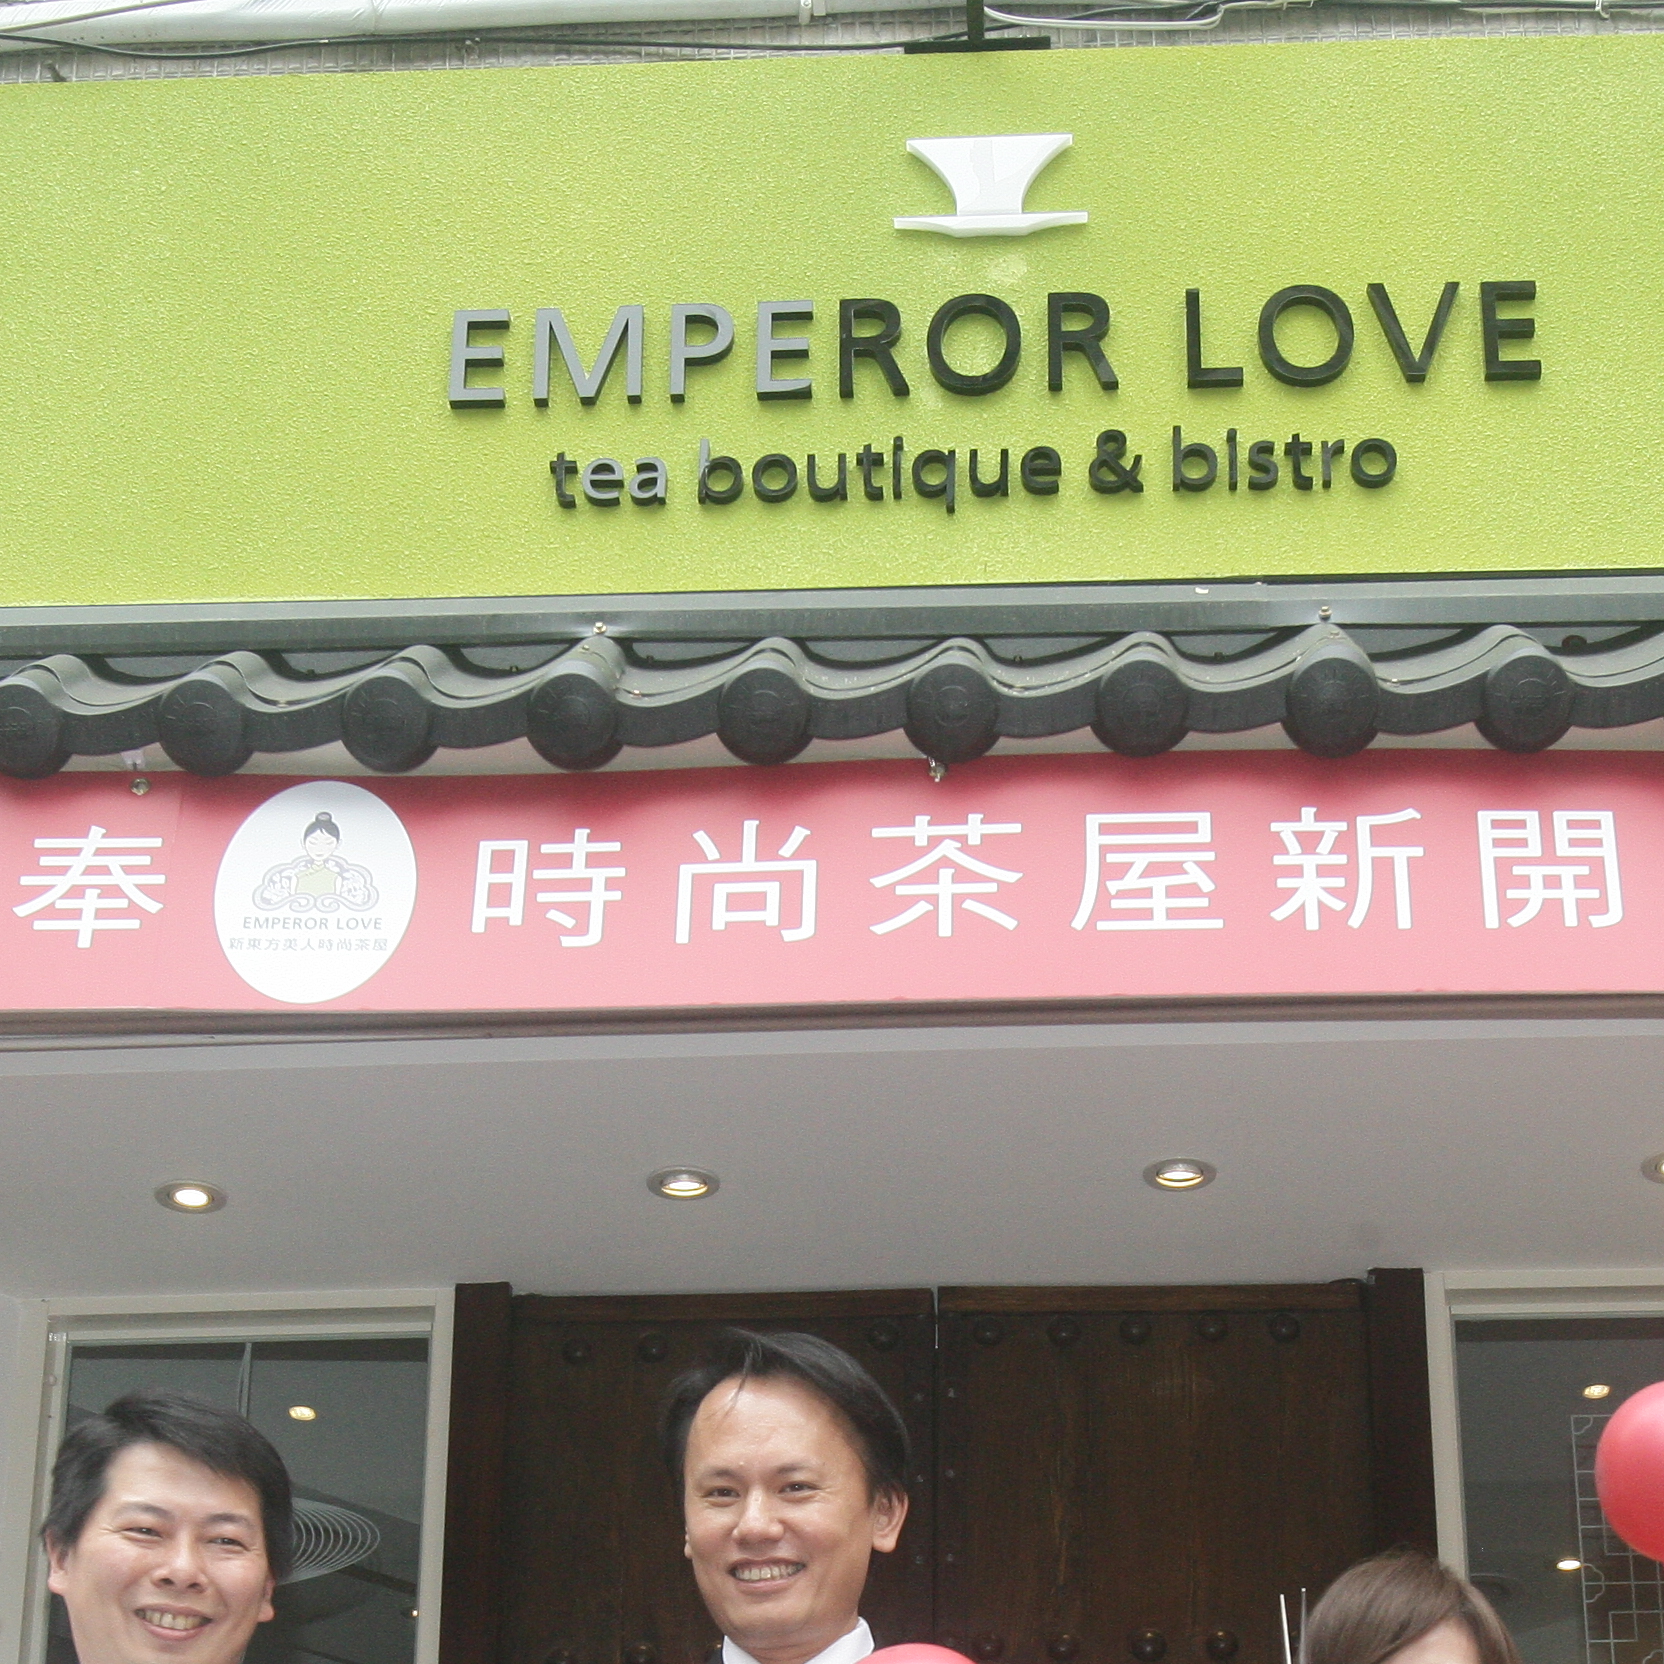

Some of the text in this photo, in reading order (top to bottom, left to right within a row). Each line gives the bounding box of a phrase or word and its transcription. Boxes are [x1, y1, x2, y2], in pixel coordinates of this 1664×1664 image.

[446, 279, 1544, 411] EMPEROR LOVE
[549, 423, 1399, 516] tea boutique & bistro
[243, 916, 383, 931] EMPEROR LOVE
